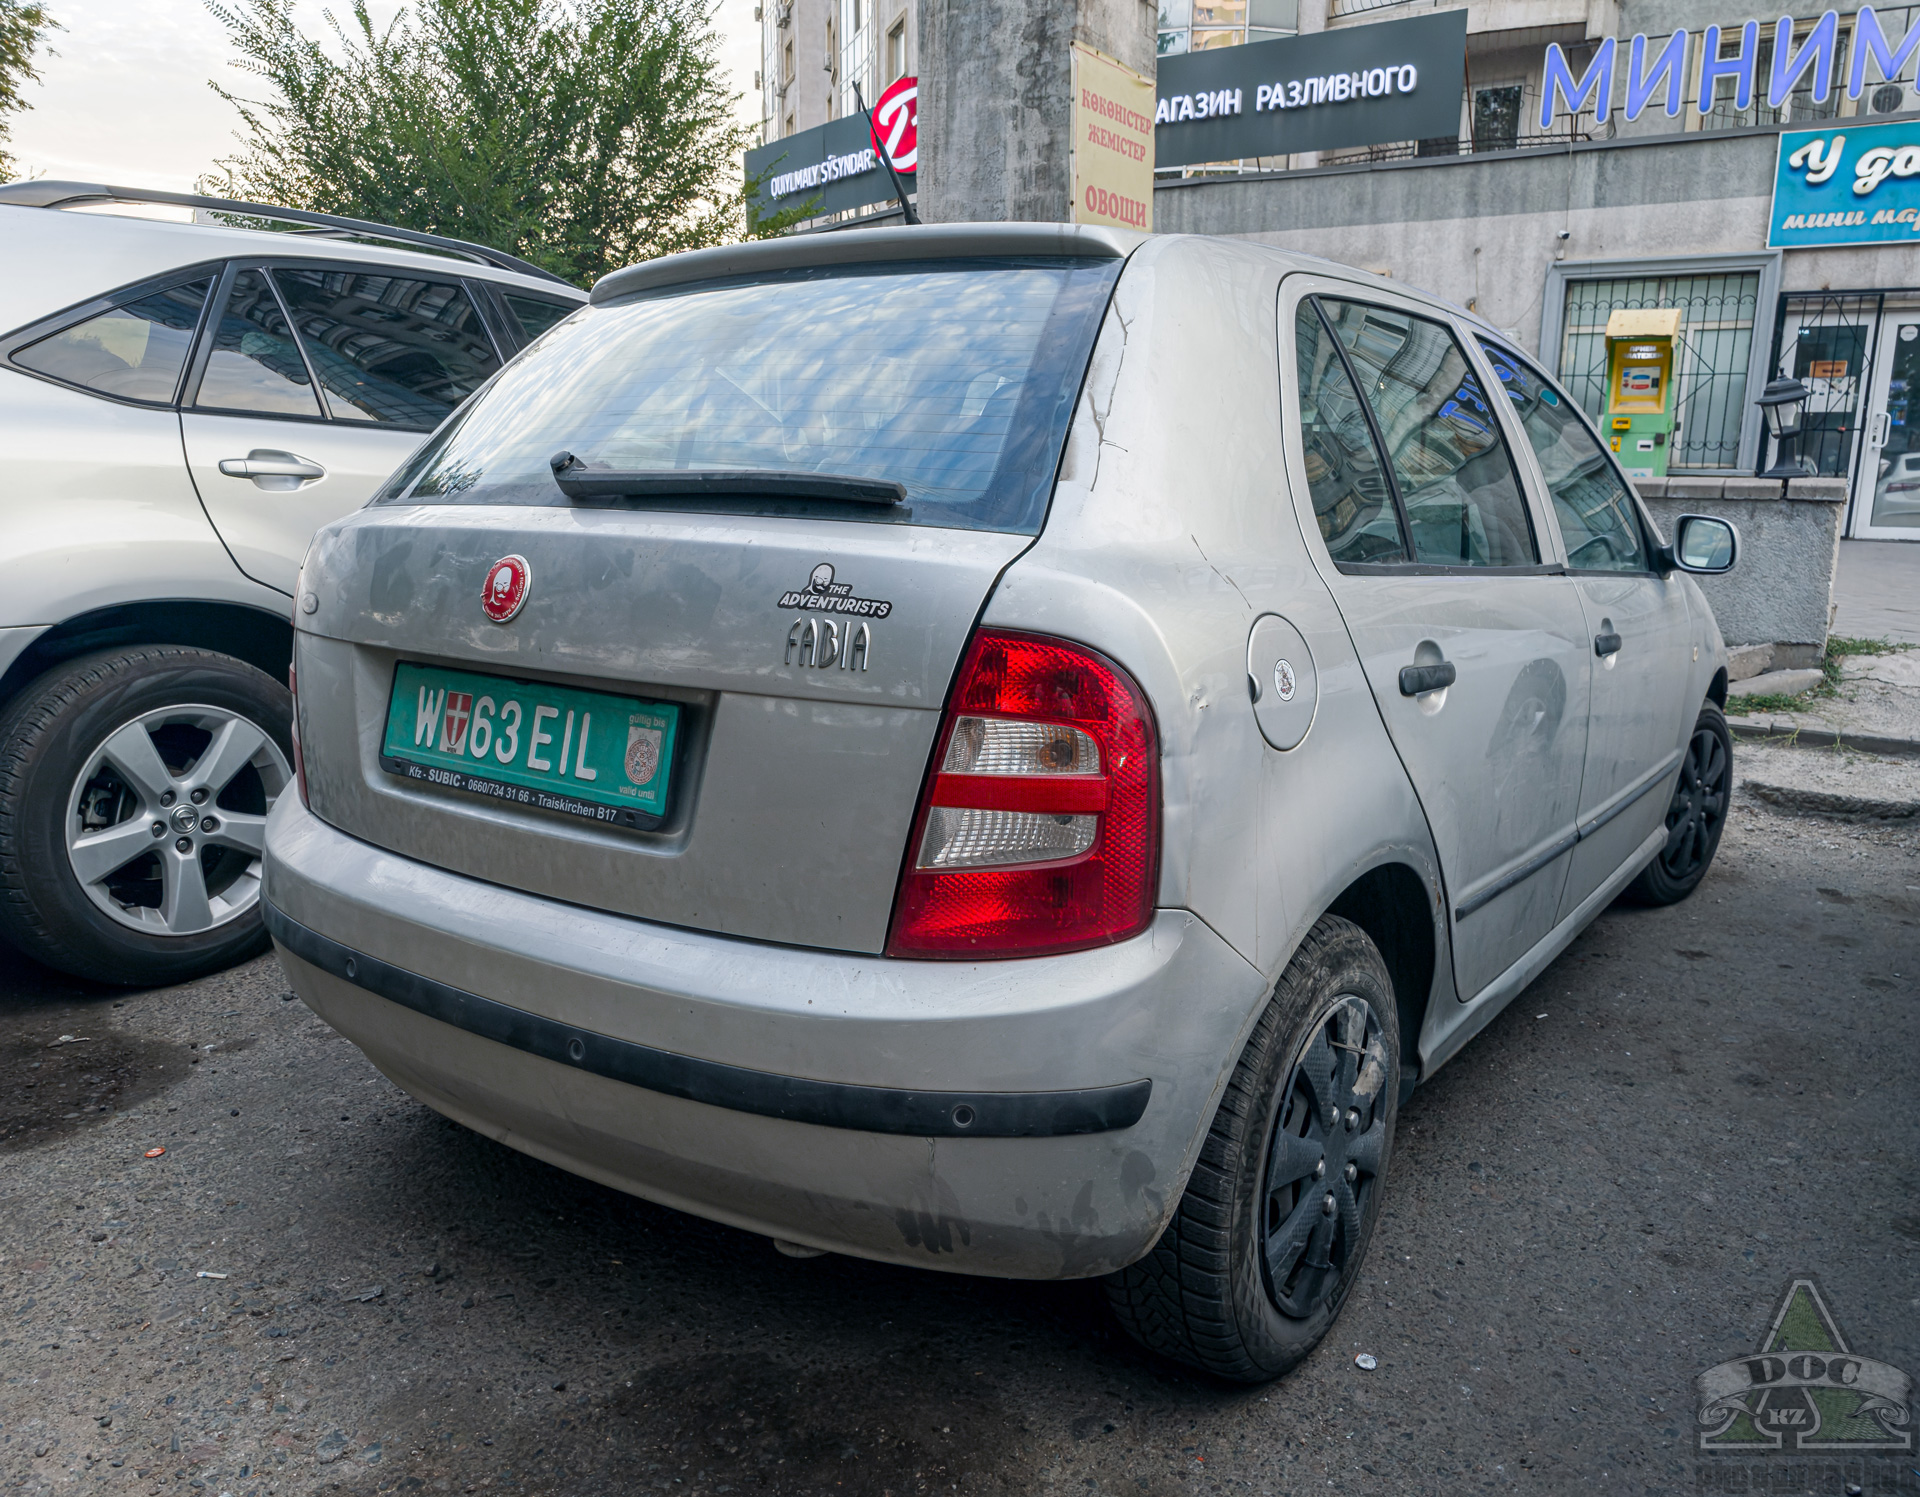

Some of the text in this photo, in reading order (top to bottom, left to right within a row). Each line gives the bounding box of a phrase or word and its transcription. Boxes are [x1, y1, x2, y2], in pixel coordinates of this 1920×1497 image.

[1539, 5, 1920, 129] МИНИМ
[1081, 88, 1152, 136] КӨКӨНІСТЕР
[1155, 64, 1416, 124] АГАЗИН РАЗЛИВНОГО
[1087, 123, 1146, 162] ЖЕМІСТЕР
[1789, 135, 1846, 183] У
[1085, 185, 1147, 228] ОВОЩИ
[1782, 210, 1868, 230] мини
[779, 592, 890, 616] ADVENTURISTS
[828, 584, 849, 595] THE
[785, 618, 870, 671] FABIA
[415, 685, 445, 748] W
[653, 717, 666, 728] bis
[408, 765, 422, 779] Kfz
[428, 768, 461, 787] SUBIC
[467, 778, 504, 797] 0660/734
[505, 787, 516, 800] 31
[518, 789, 530, 803] 66
[538, 793, 595, 817] Traiskirchen
[596, 806, 617, 822] B17
[619, 785, 655, 800] valid until
